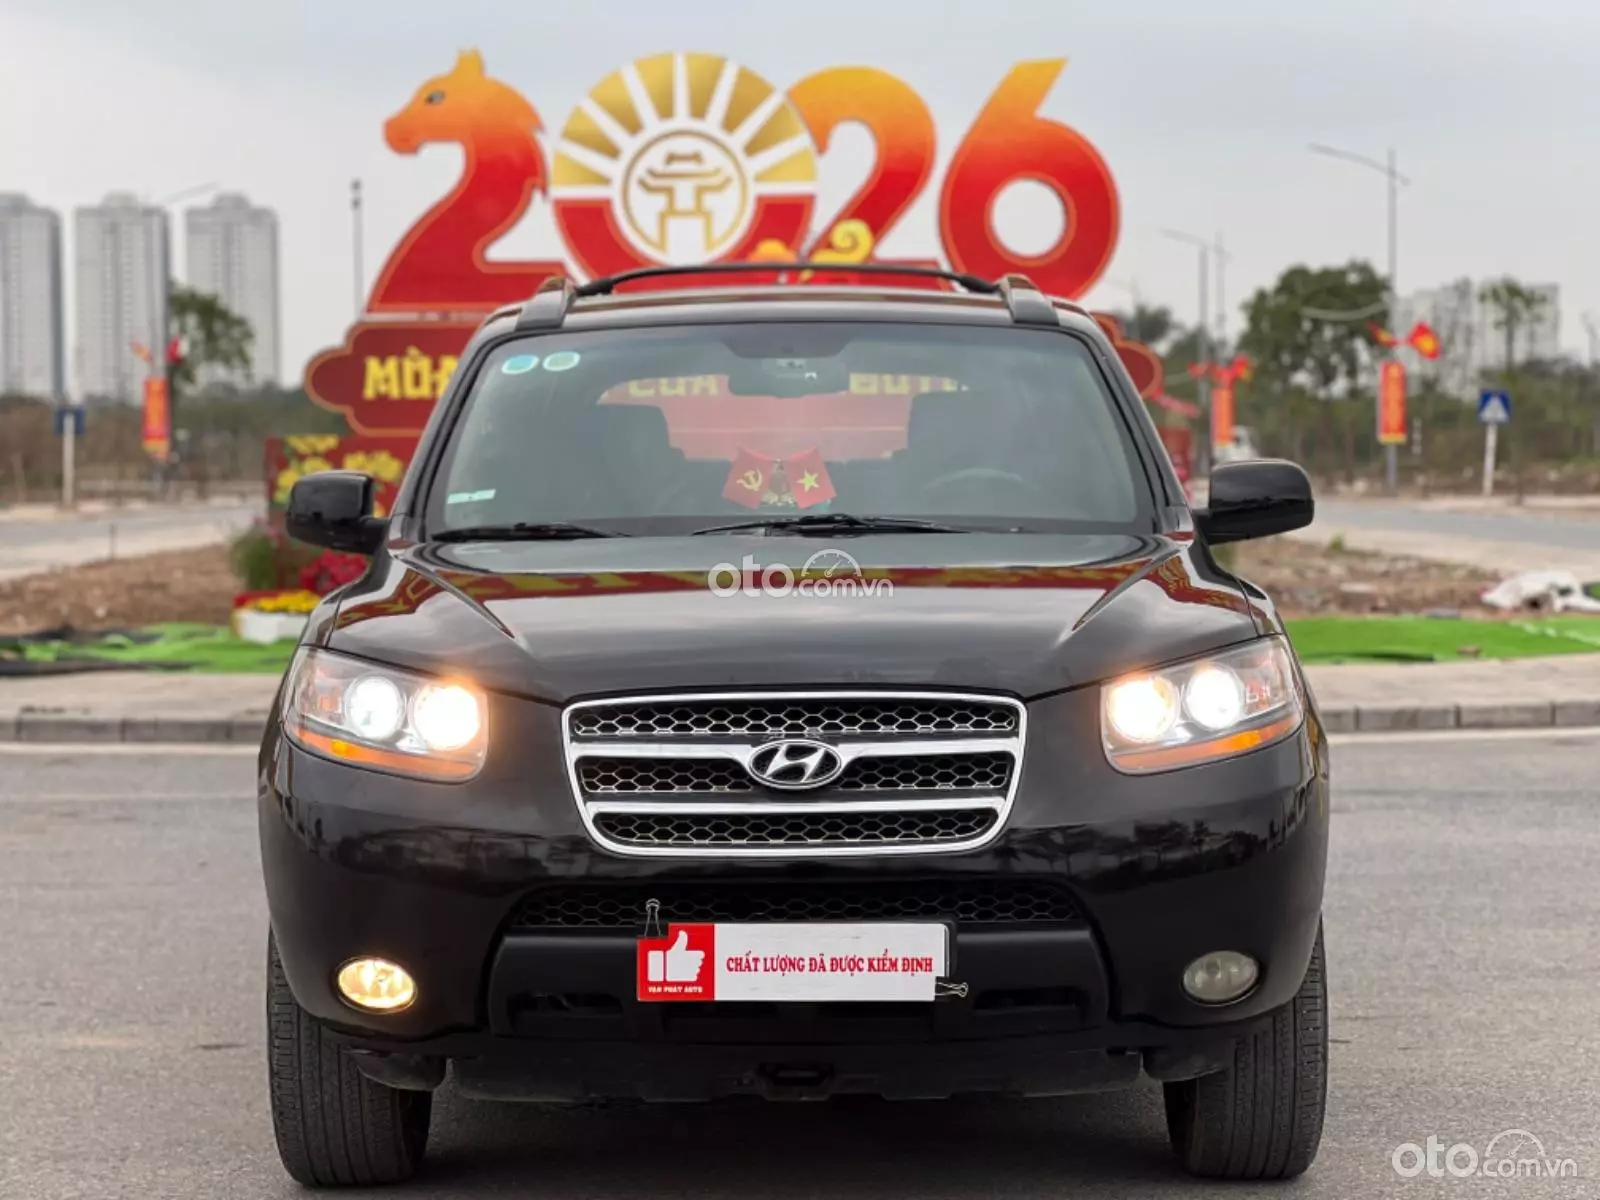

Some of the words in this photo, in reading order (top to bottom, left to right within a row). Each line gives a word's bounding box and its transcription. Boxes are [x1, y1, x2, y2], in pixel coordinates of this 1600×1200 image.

[367, 48, 1121, 313] 2026
[726, 950, 760, 972] CHẤT
[763, 954, 805, 976] LƯỢNG
[808, 953, 827, 972] ĐÃ
[830, 955, 864, 976] ĐƯỢC
[867, 948, 899, 972] KIỂM
[901, 957, 934, 976] ĐỊNH
